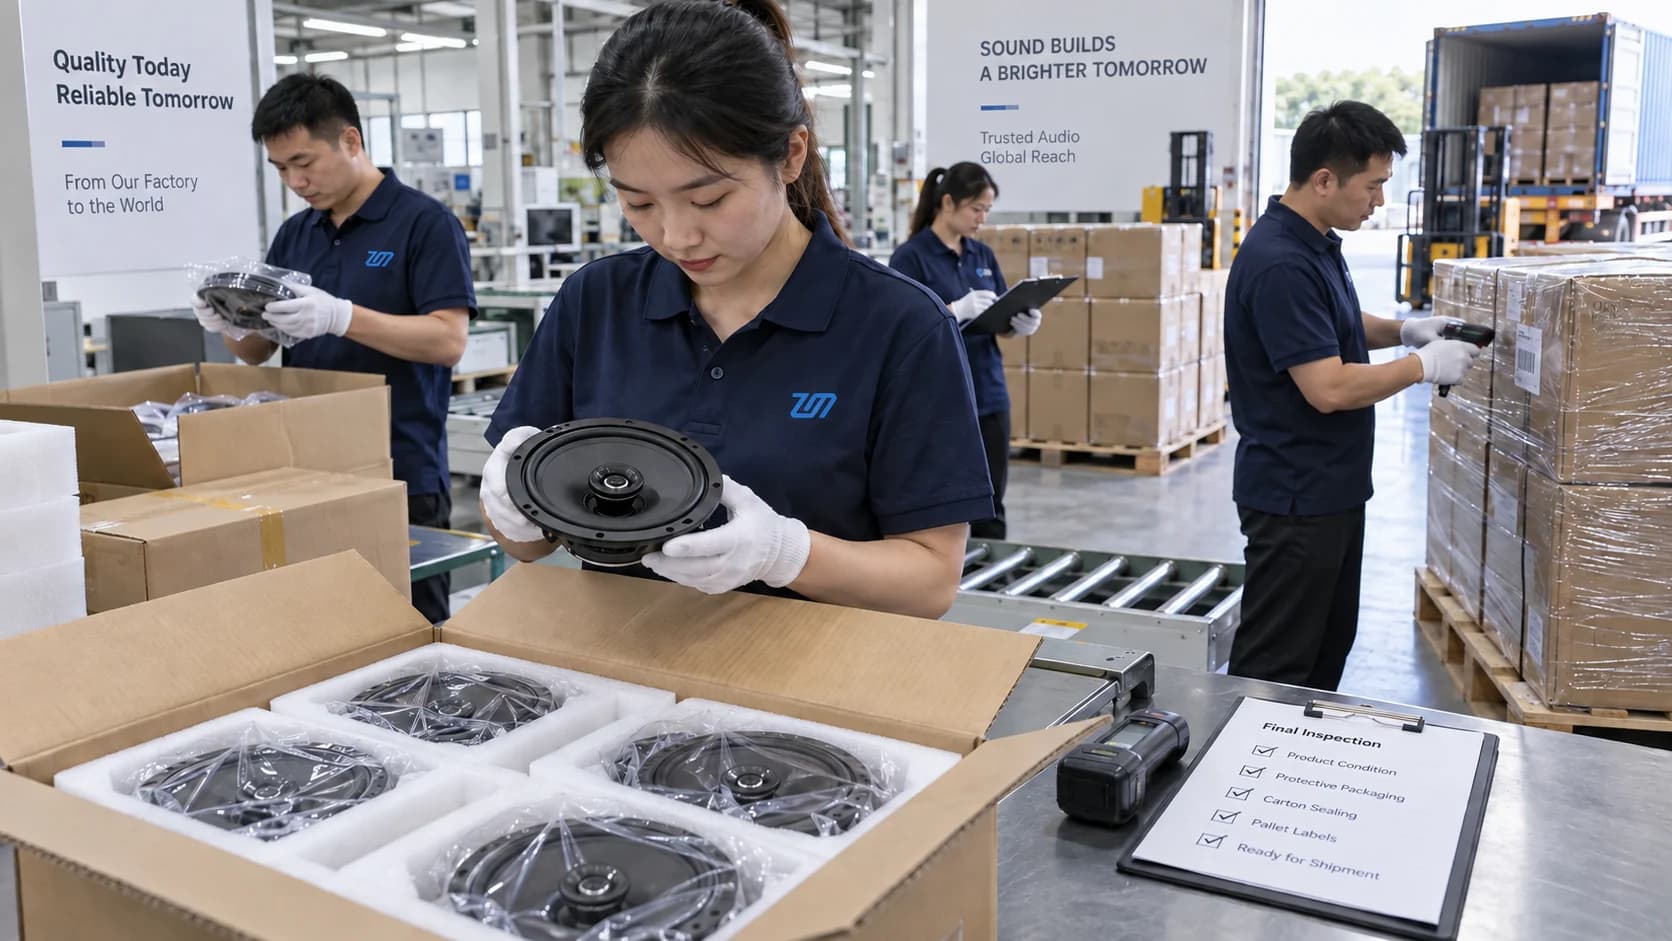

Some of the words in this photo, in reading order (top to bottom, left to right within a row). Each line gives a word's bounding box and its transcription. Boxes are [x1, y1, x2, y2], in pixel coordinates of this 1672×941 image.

[980, 39, 1044, 56] SOUND
[1051, 36, 1116, 53] BUILDS
[53, 49, 127, 78] Quality
[132, 55, 191, 83] Today
[980, 65, 992, 81] A
[998, 62, 1087, 80] BRIGHTER
[1093, 58, 1207, 77] TOMORROW
[56, 84, 136, 106] Reliable
[141, 88, 234, 110] Tomorrow
[980, 131, 1033, 144] Trusted
[1038, 130, 1080, 143] Audio
[980, 151, 1026, 164] Global
[1031, 149, 1076, 163] Reach
[65, 174, 105, 190] From
[111, 174, 139, 190] Our
[145, 174, 198, 192] Factory
[67, 199, 84, 214] to
[90, 198, 115, 214] the
[121, 196, 164, 213] World
[1262, 722, 1299, 735] Final
[1302, 728, 1382, 749] Inspection
[1287, 751, 1335, 766] Product
[1338, 760, 1397, 776] Condition
[1275, 773, 1338, 790] Protective
[1341, 784, 1406, 803] Packaging
[1263, 795, 1307, 811] Carton
[1310, 804, 1358, 821] Sealing
[1251, 818, 1290, 834] Pallet
[1293, 826, 1337, 843] Labels
[1237, 843, 1282, 861] Ready
[1285, 853, 1305, 866] for
[1310, 859, 1380, 881] Shipment
